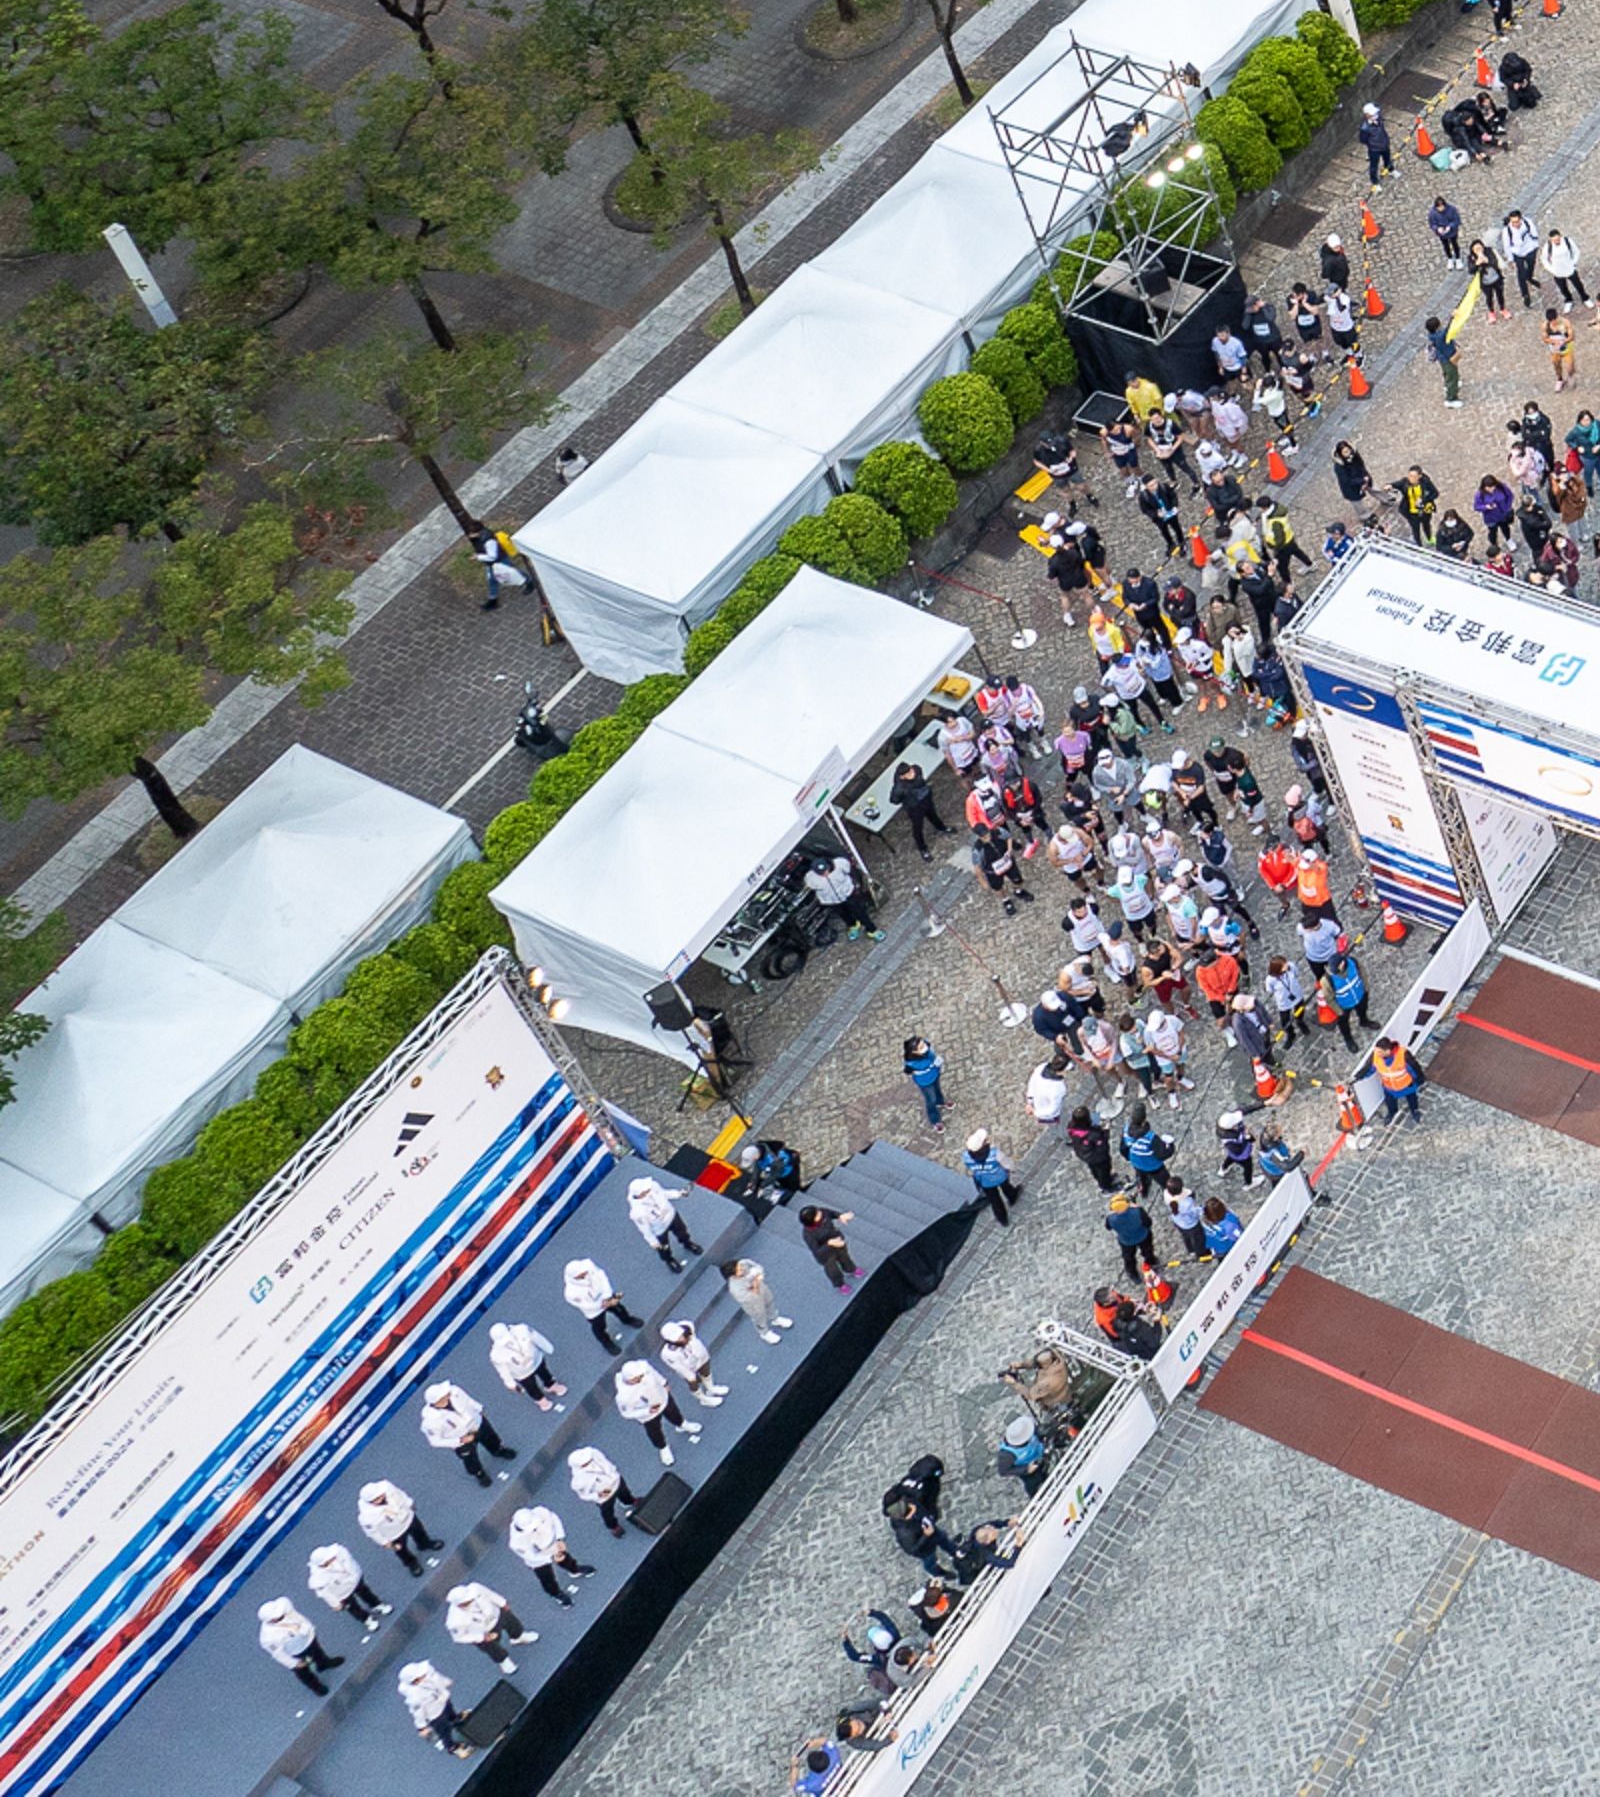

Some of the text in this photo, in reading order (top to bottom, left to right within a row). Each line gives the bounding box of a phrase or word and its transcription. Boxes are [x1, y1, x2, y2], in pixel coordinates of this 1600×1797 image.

[1366, 588, 1425, 614] Financial
[1376, 605, 1415, 626] Fubon
[1423, 608, 1545, 666] 富邦金控
[275, 1205, 343, 1280] 富邦金控
[339, 1188, 396, 1251] CITIZEN
[1200, 1251, 1259, 1333] 富邦金控
[46, 1376, 176, 1509] Redefine Your Limits
[210, 1432, 279, 1503] Redefine
[275, 1393, 313, 1435] Your
[306, 1344, 357, 1400] Limits
